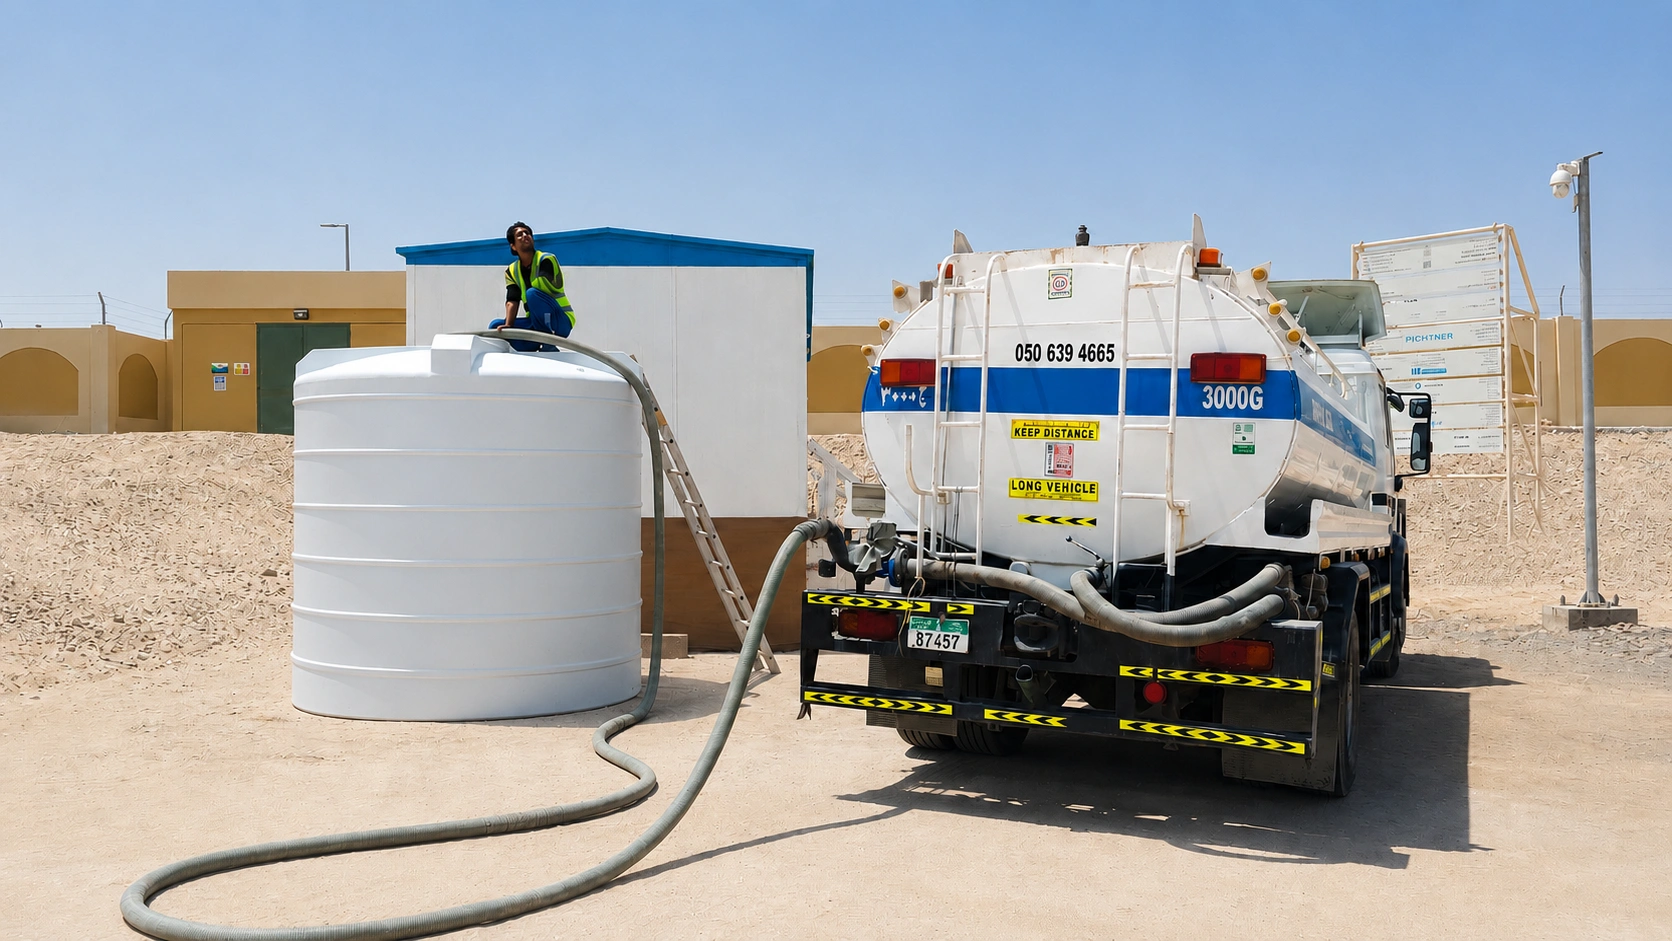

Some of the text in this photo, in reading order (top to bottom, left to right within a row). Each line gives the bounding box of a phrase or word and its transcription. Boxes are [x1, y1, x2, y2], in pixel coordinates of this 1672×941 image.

[1015, 343, 1115, 362] 050 639 4665
[1202, 385, 1264, 411] 3000G
[1014, 427, 1095, 439] KEEP DISTANCE
[1011, 480, 1096, 494] LONG VEHICLE
[916, 632, 960, 649] 87457
